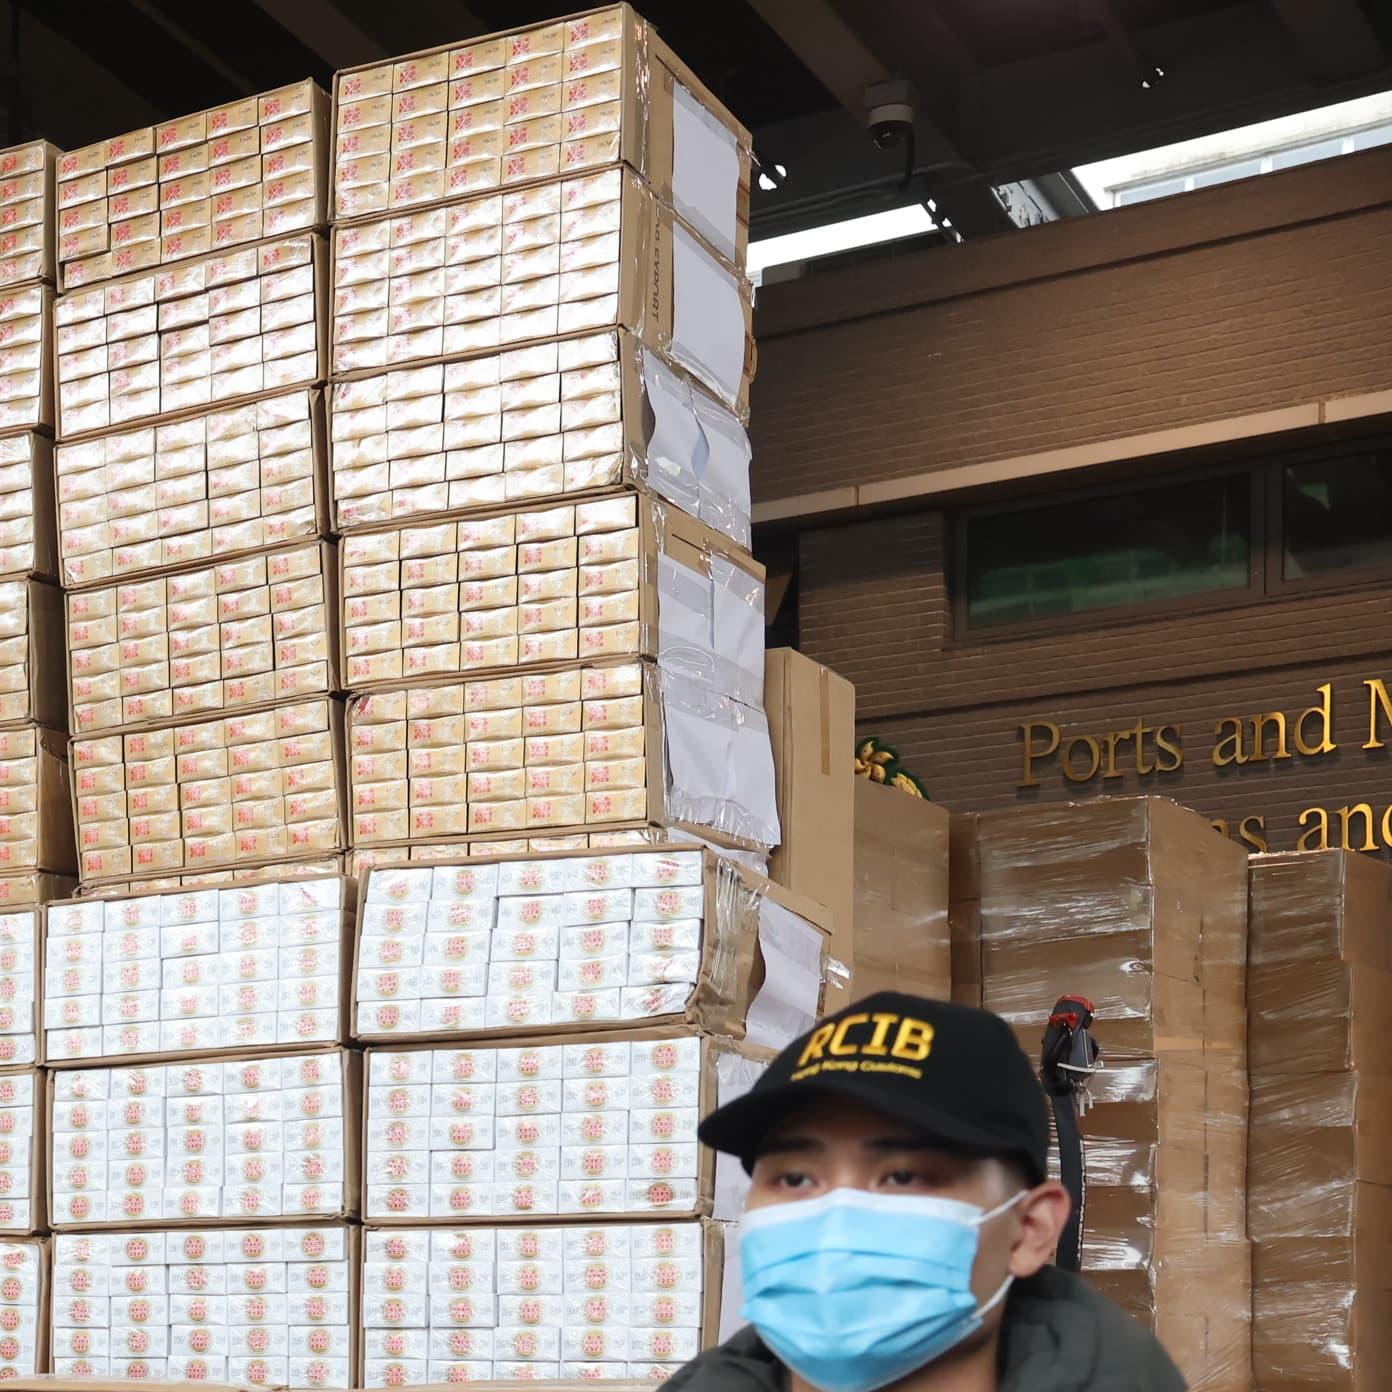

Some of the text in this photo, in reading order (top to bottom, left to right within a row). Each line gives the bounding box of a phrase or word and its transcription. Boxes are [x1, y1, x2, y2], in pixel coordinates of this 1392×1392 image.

[1019, 716, 1184, 787] Ports
[1212, 682, 1337, 767] and
[1297, 801, 1392, 852] an
[797, 1012, 935, 1067] RCIB
